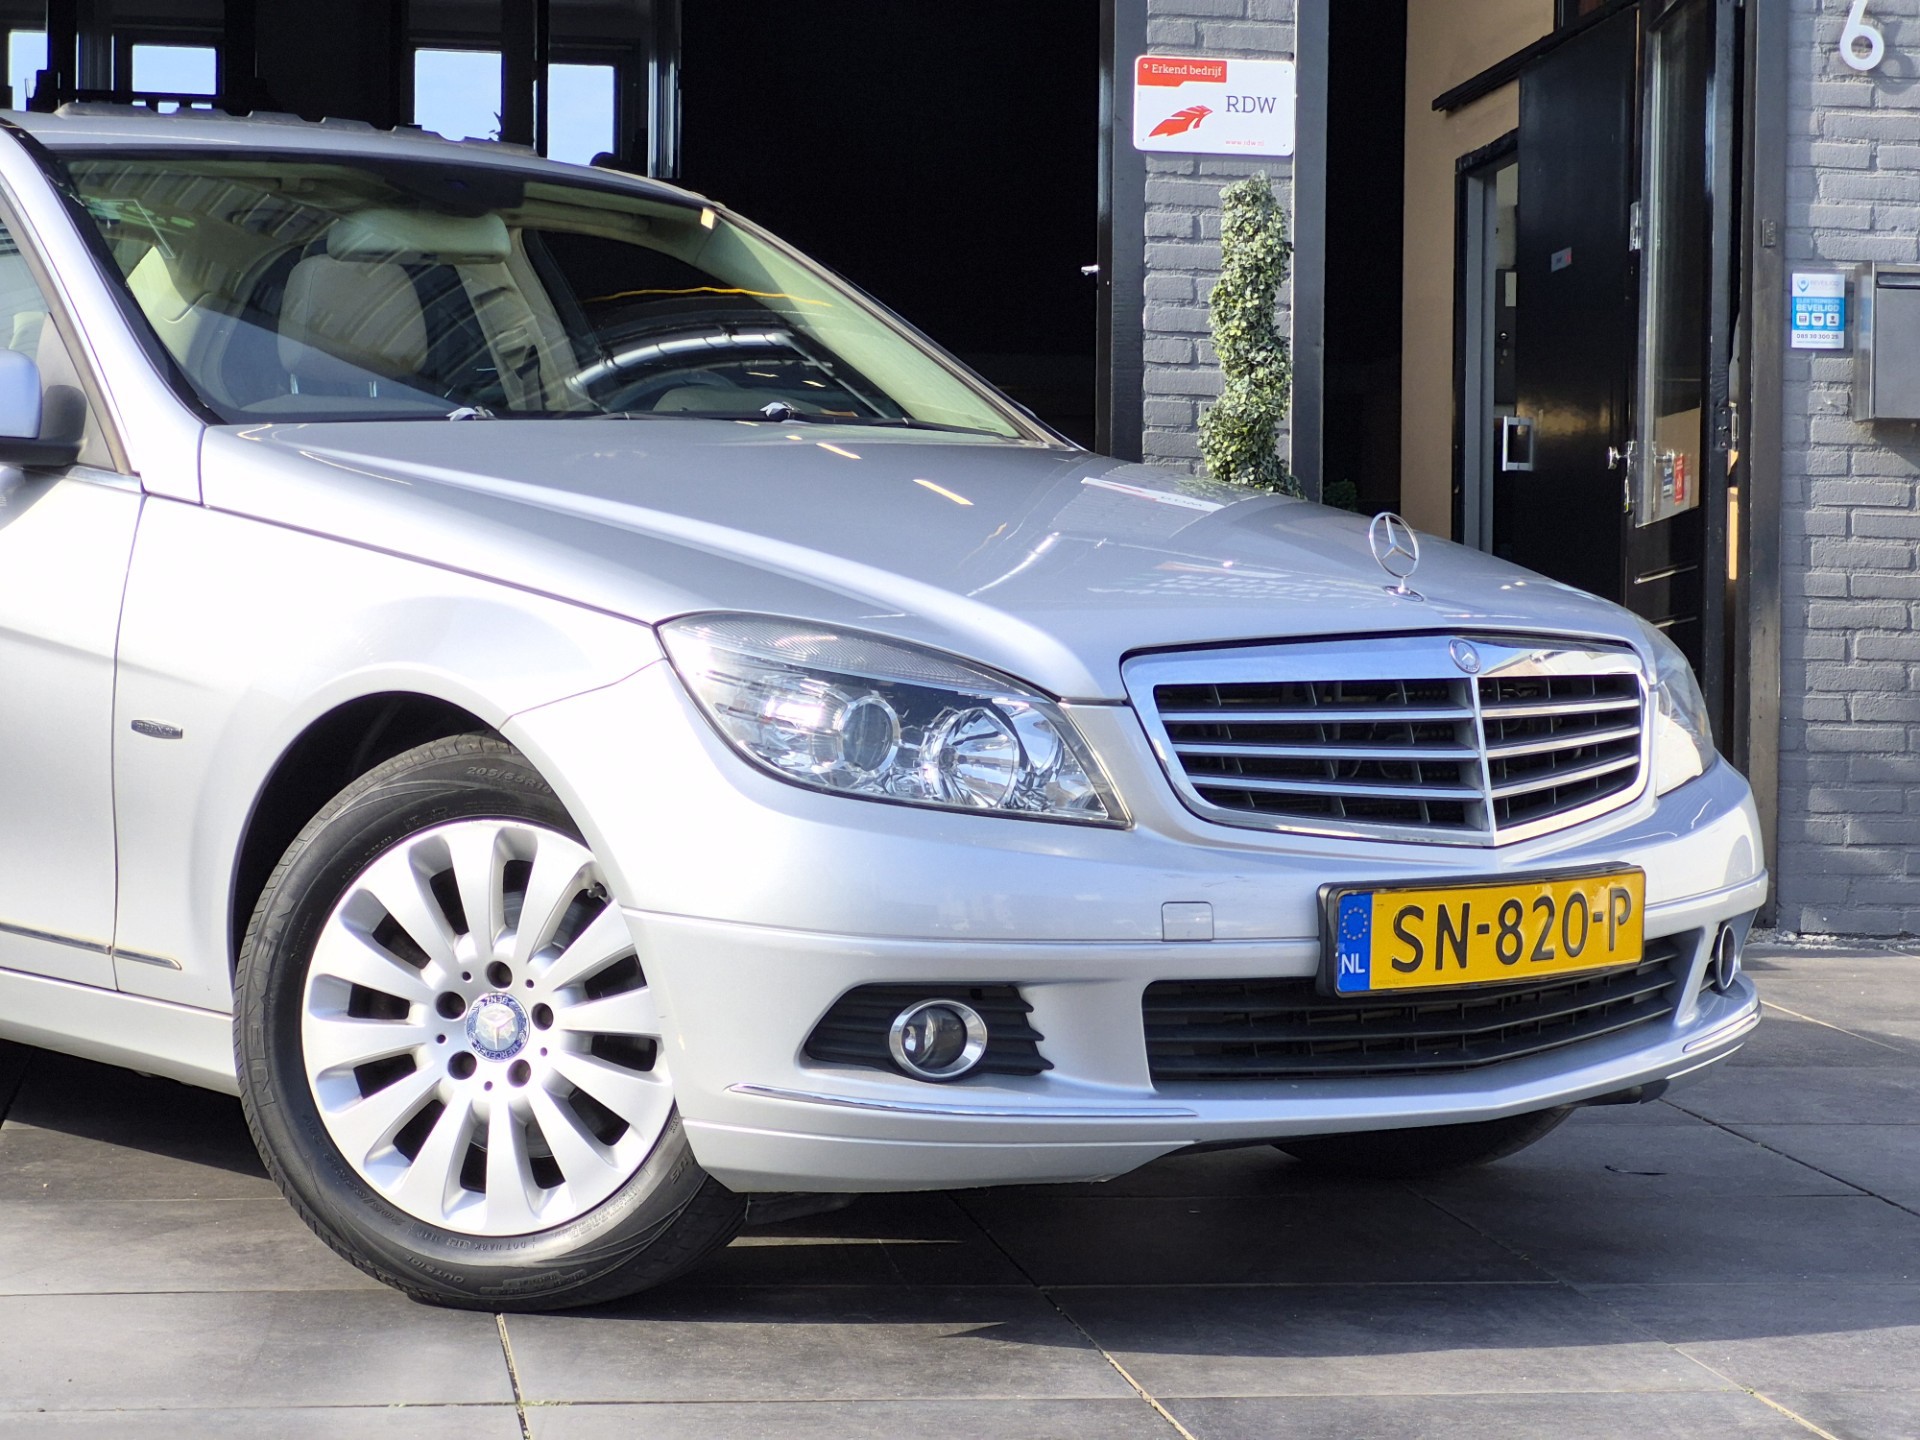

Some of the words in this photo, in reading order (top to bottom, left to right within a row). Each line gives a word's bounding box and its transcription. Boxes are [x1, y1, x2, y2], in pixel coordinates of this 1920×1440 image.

[1839, 0, 1885, 71] 6
[1151, 63, 1187, 75] Erkend
[1189, 65, 1222, 78] bedrijf
[1225, 95, 1277, 114] RDW
[1796, 304, 1840, 312] BEVEILIGD
[1391, 887, 1633, 973] SN-820-P
[1341, 953, 1366, 974] NL
[485, 995, 510, 1004] BENZ
[475, 1041, 520, 1060] MERCEDES
